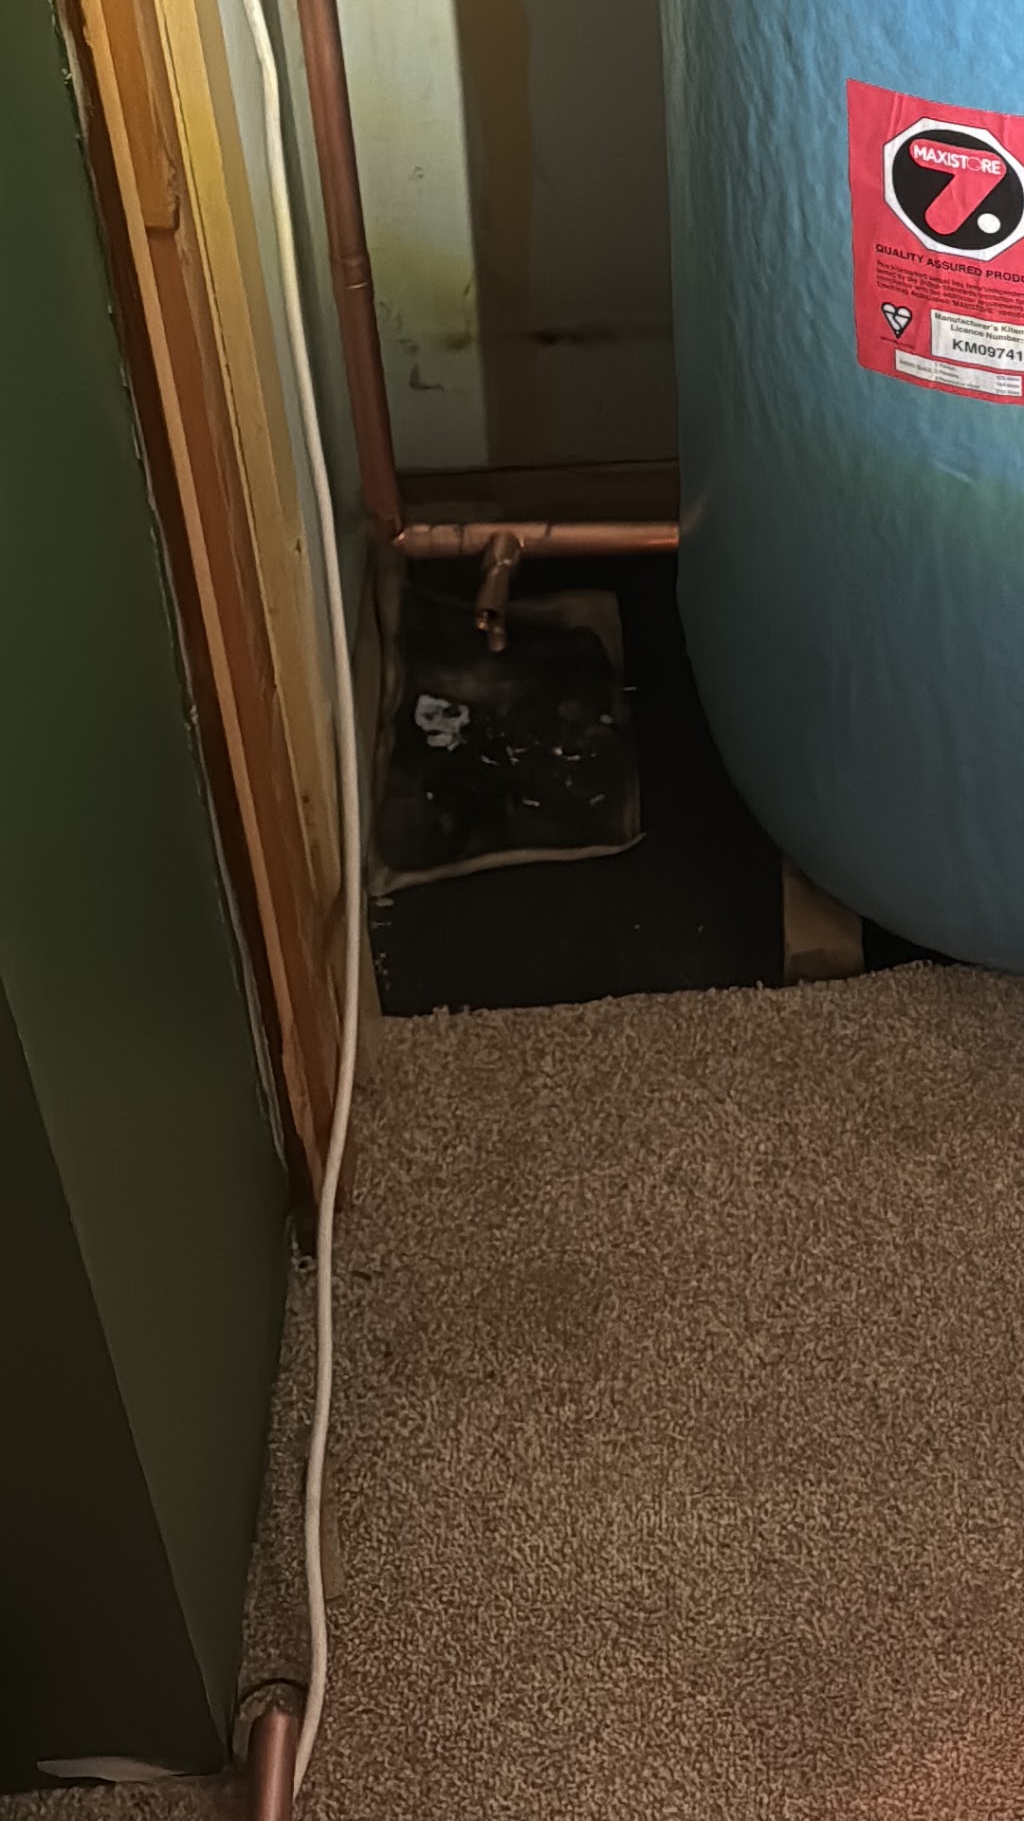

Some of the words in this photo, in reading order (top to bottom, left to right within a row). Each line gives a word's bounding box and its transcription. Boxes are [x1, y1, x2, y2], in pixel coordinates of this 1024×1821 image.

[913, 144, 1002, 175] MAXISTORE
[875, 243, 924, 263] QUALITY
[926, 258, 982, 276] ASSURED
[934, 312, 999, 332] Manufacturer's
[950, 324, 984, 338] Licence
[952, 338, 1023, 362] KM09741
